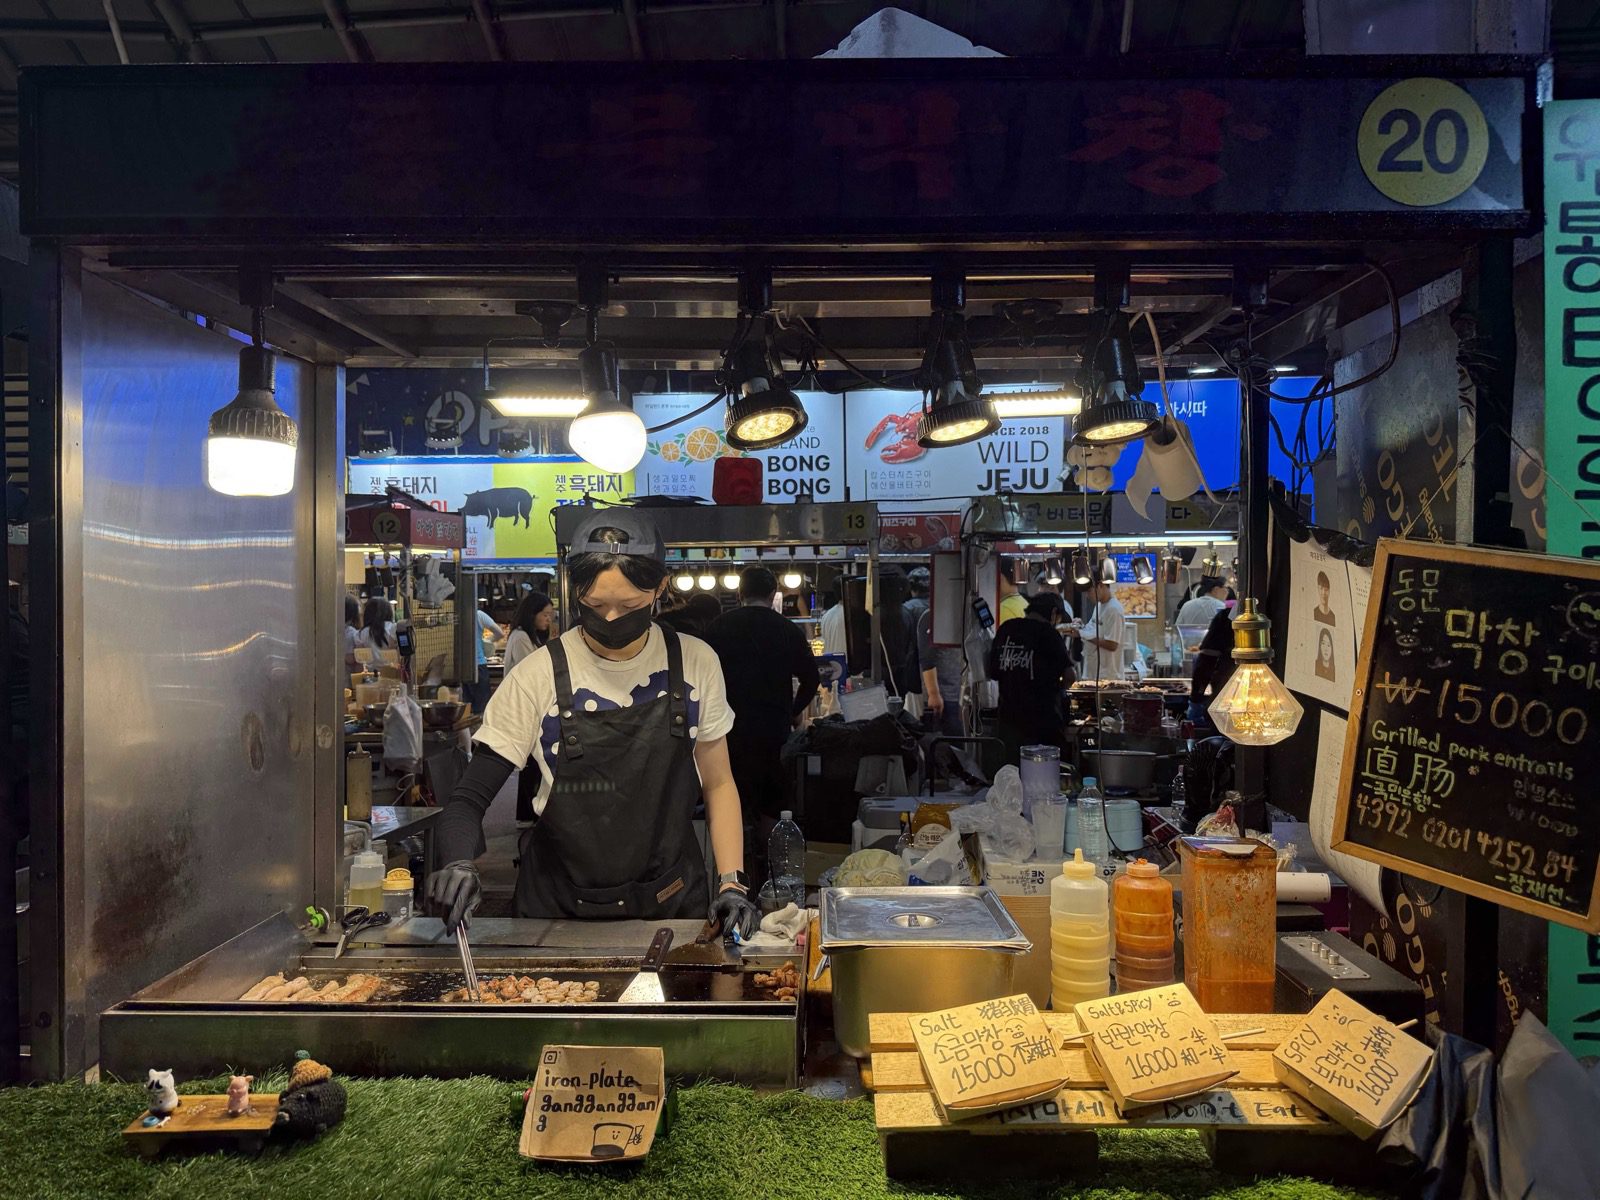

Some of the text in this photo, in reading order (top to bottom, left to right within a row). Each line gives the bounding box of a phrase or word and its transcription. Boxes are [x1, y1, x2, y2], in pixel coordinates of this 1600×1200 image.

[1377, 108, 1470, 174] 20
[1020, 426, 1049, 436] 2018
[768, 455, 830, 472] BONG
[977, 441, 1049, 464] WILD
[570, 475, 623, 493] 흑돼지
[768, 478, 831, 496] BONG
[977, 468, 1049, 491] JEJU
[379, 521, 397, 533] 12
[847, 515, 866, 529] 13
[1393, 569, 1441, 612] 동문
[1445, 609, 1597, 689] 막창 구이
[1371, 719, 1575, 781] Grilled pork entrails
[1360, 745, 1456, 799] 直肠
[1356, 792, 1412, 840] 4392
[1476, 829, 1537, 877] 4252
[1543, 849, 1580, 884] 84
[919, 1013, 962, 1036] Salt
[1098, 1017, 1170, 1050] 반반막창
[934, 1023, 1003, 1064] 소금막창
[951, 1053, 1016, 1094] 15000
[1125, 1046, 1179, 1080] 16000
[1355, 1058, 1399, 1107] 16000
[1163, 1095, 1306, 1121] Don't Eat
